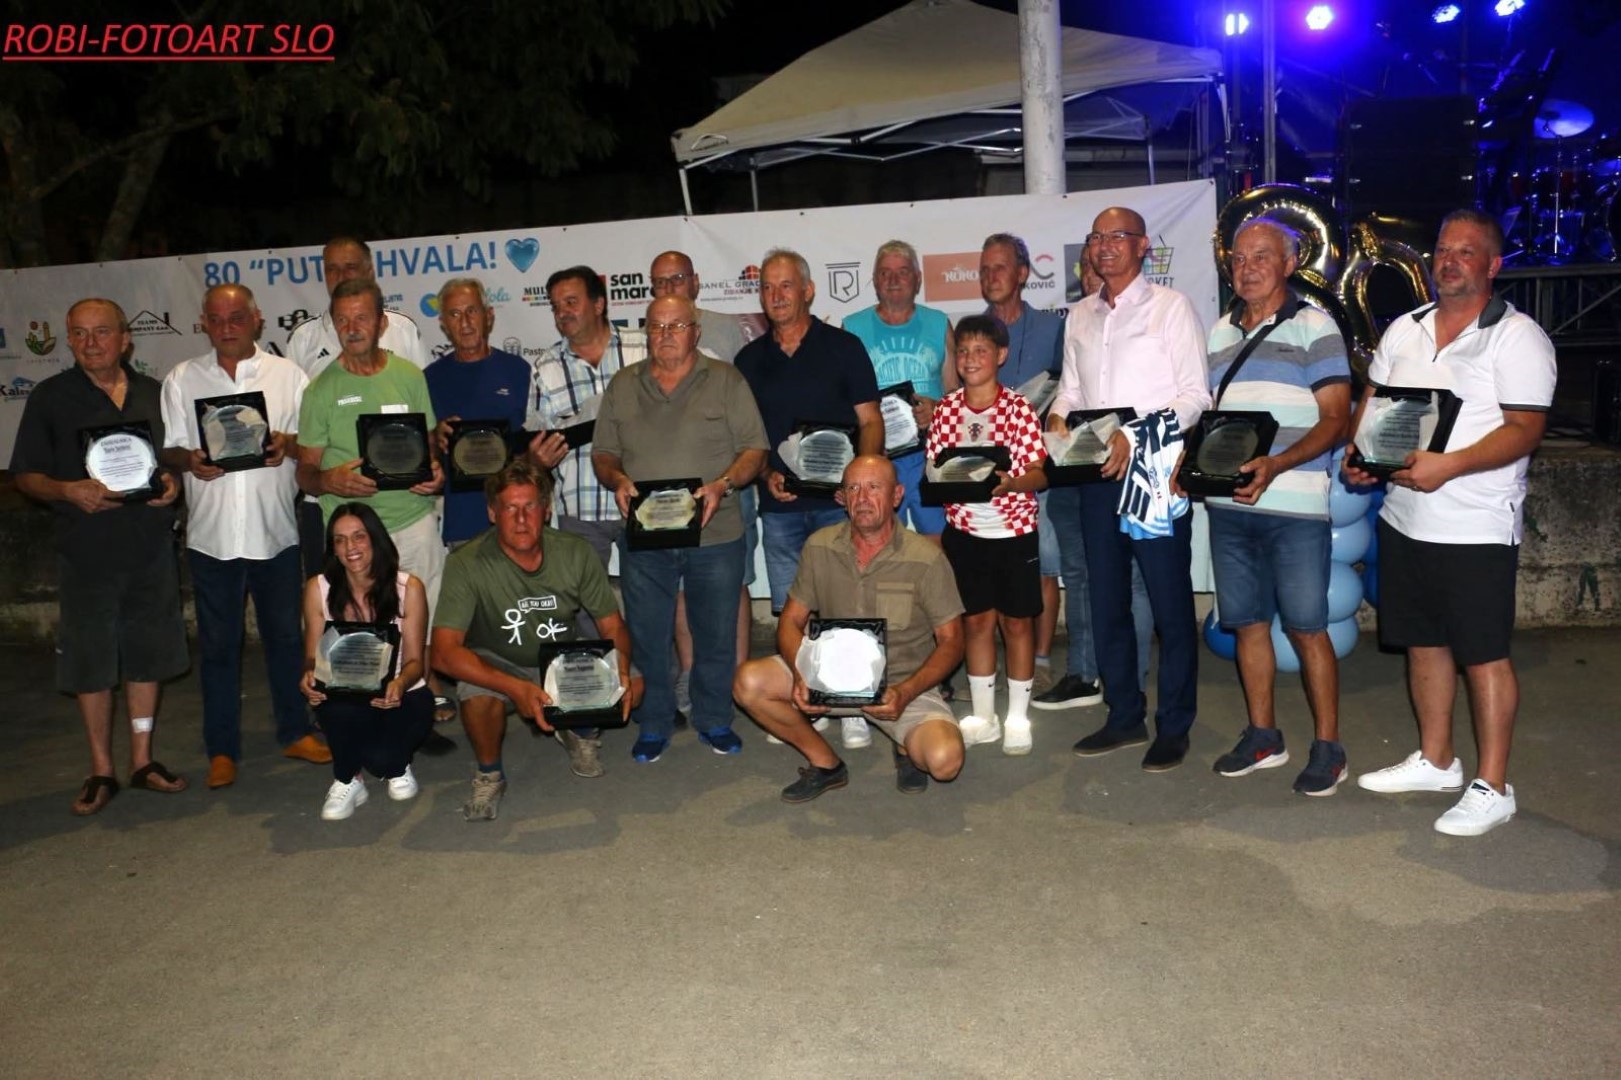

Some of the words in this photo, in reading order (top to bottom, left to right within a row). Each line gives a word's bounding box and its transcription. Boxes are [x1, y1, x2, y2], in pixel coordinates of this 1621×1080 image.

[204, 261, 241, 287] 80
[377, 241, 497, 278] HVALA!
[611, 272, 644, 287] san
[1024, 279, 1056, 290] KOVIĆ
[523, 286, 548, 296] MUL
